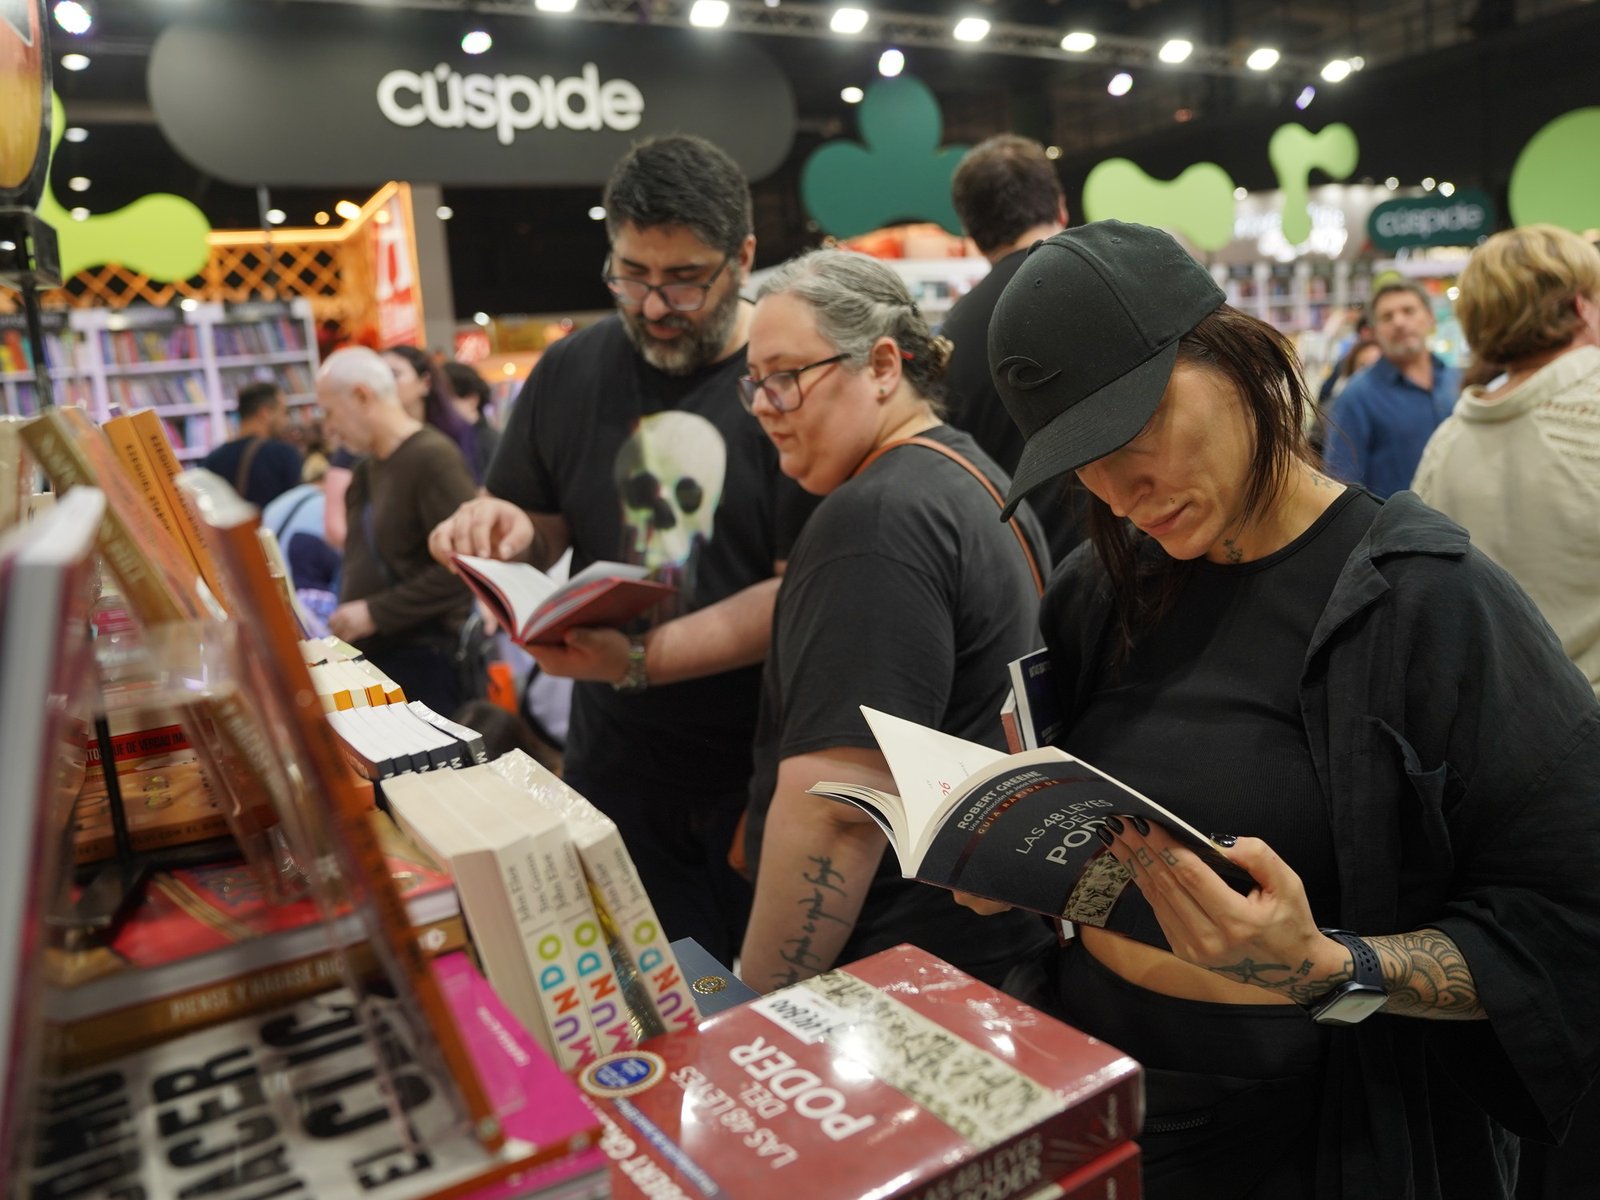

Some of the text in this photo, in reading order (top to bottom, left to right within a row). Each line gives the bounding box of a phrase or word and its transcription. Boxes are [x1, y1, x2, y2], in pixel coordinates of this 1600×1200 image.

[376, 62, 645, 146] cúspide
[957, 770, 1043, 830] ROBERT GREENE
[968, 819, 980, 832] Una
[979, 794, 1008, 820] producción
[1015, 799, 1114, 855] LAS 48 LEYES
[1058, 813, 1096, 831] DEL
[1045, 819, 1107, 866] POD
[537, 933, 598, 1072] MUNDO
[573, 920, 638, 1053] MUNDO
[632, 919, 701, 1032] MUNDO
[669, 1064, 737, 1117] LEYES
[728, 1035, 877, 1142] PODER
[738, 1080, 788, 1120] DEL
[719, 1104, 758, 1134] 48
[743, 1127, 800, 1170] LAS
